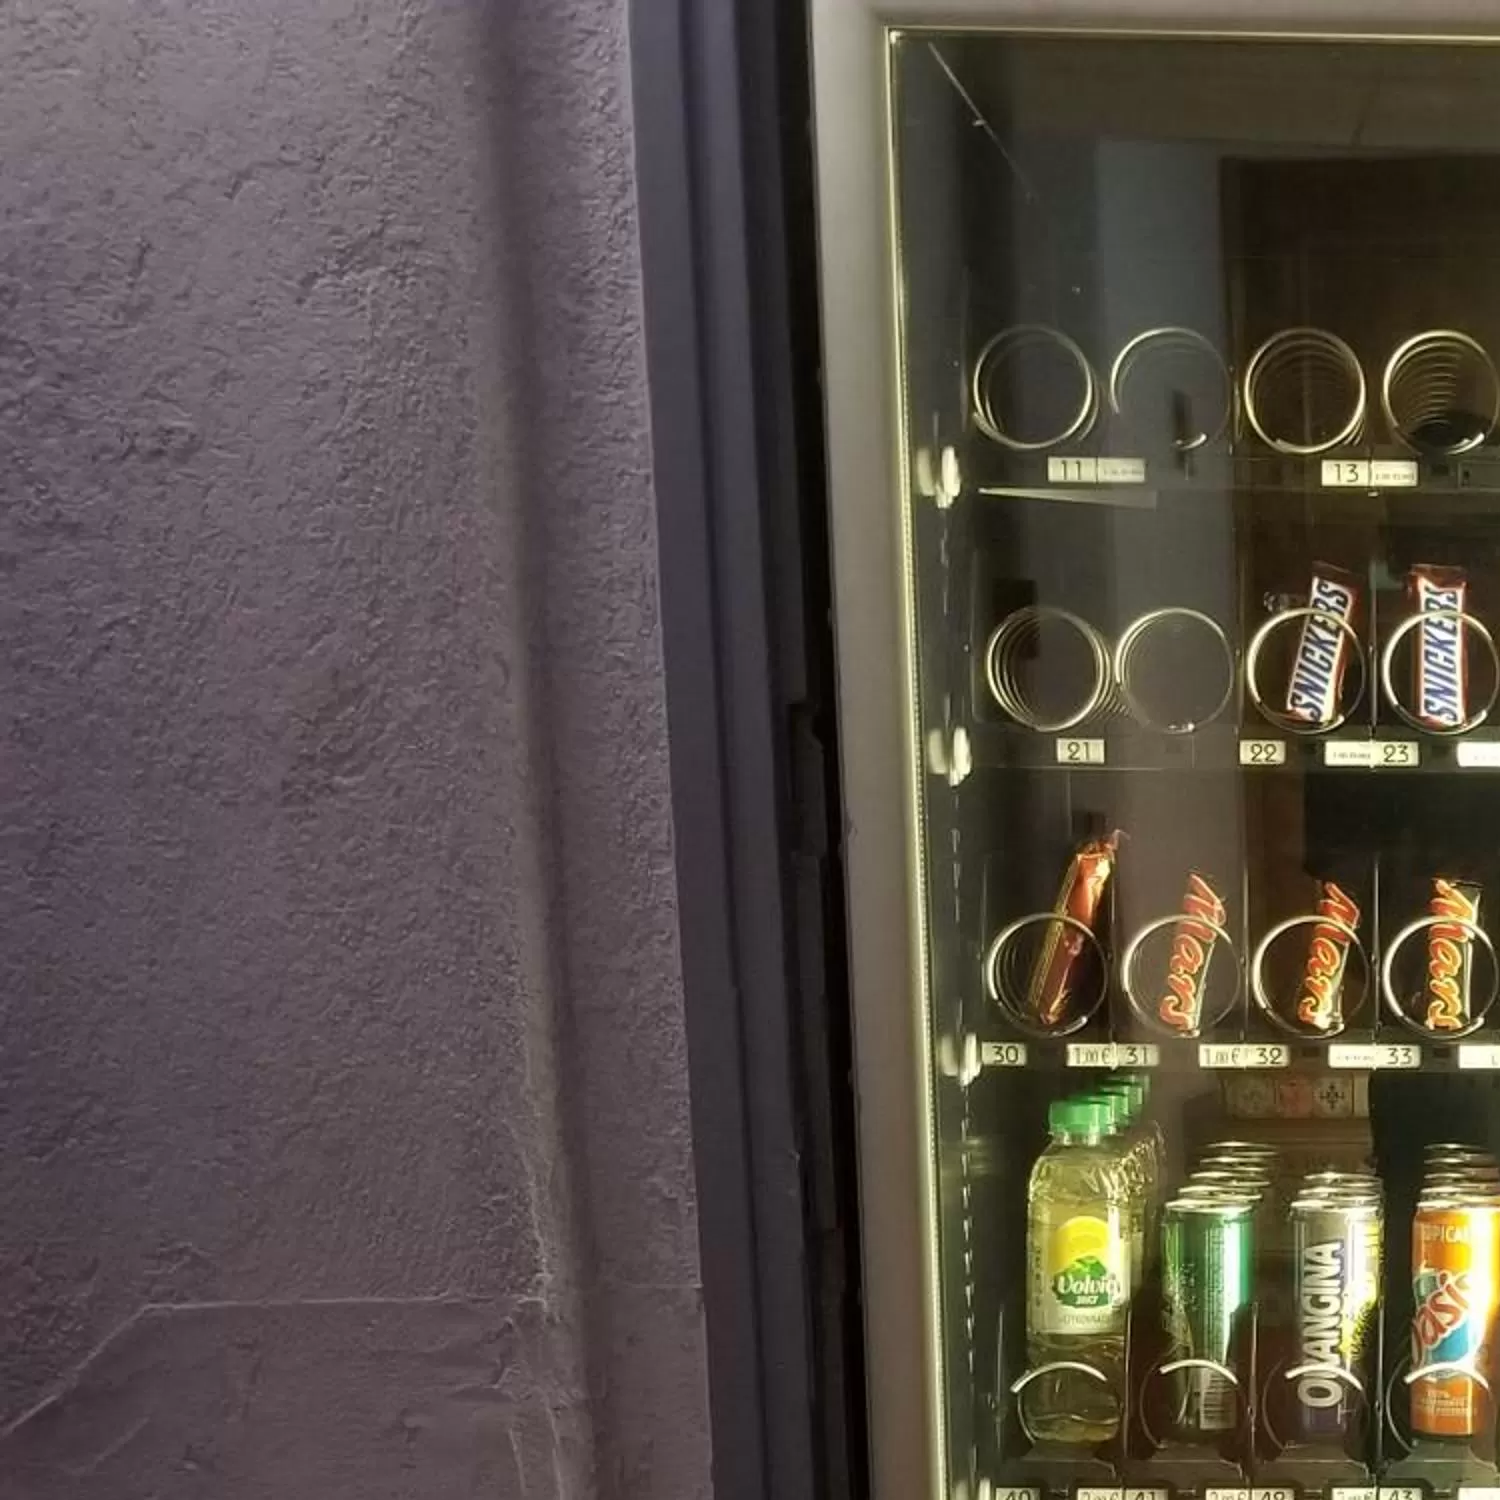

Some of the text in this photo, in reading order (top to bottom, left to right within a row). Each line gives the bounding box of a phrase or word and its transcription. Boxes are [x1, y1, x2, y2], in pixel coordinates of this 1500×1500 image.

[1060, 461, 1082, 480] 11
[1333, 463, 1359, 482] 13
[1289, 578, 1348, 722] SNICKERS
[1423, 585, 1460, 726] SNICKERS
[1067, 742, 1091, 761] 21
[1249, 744, 1277, 762] 22
[1383, 744, 1410, 763] 23
[993, 1046, 1019, 1064] 30
[1127, 1047, 1148, 1064] 31
[1256, 1047, 1283, 1065] 32
[1387, 1047, 1412, 1064] 33
